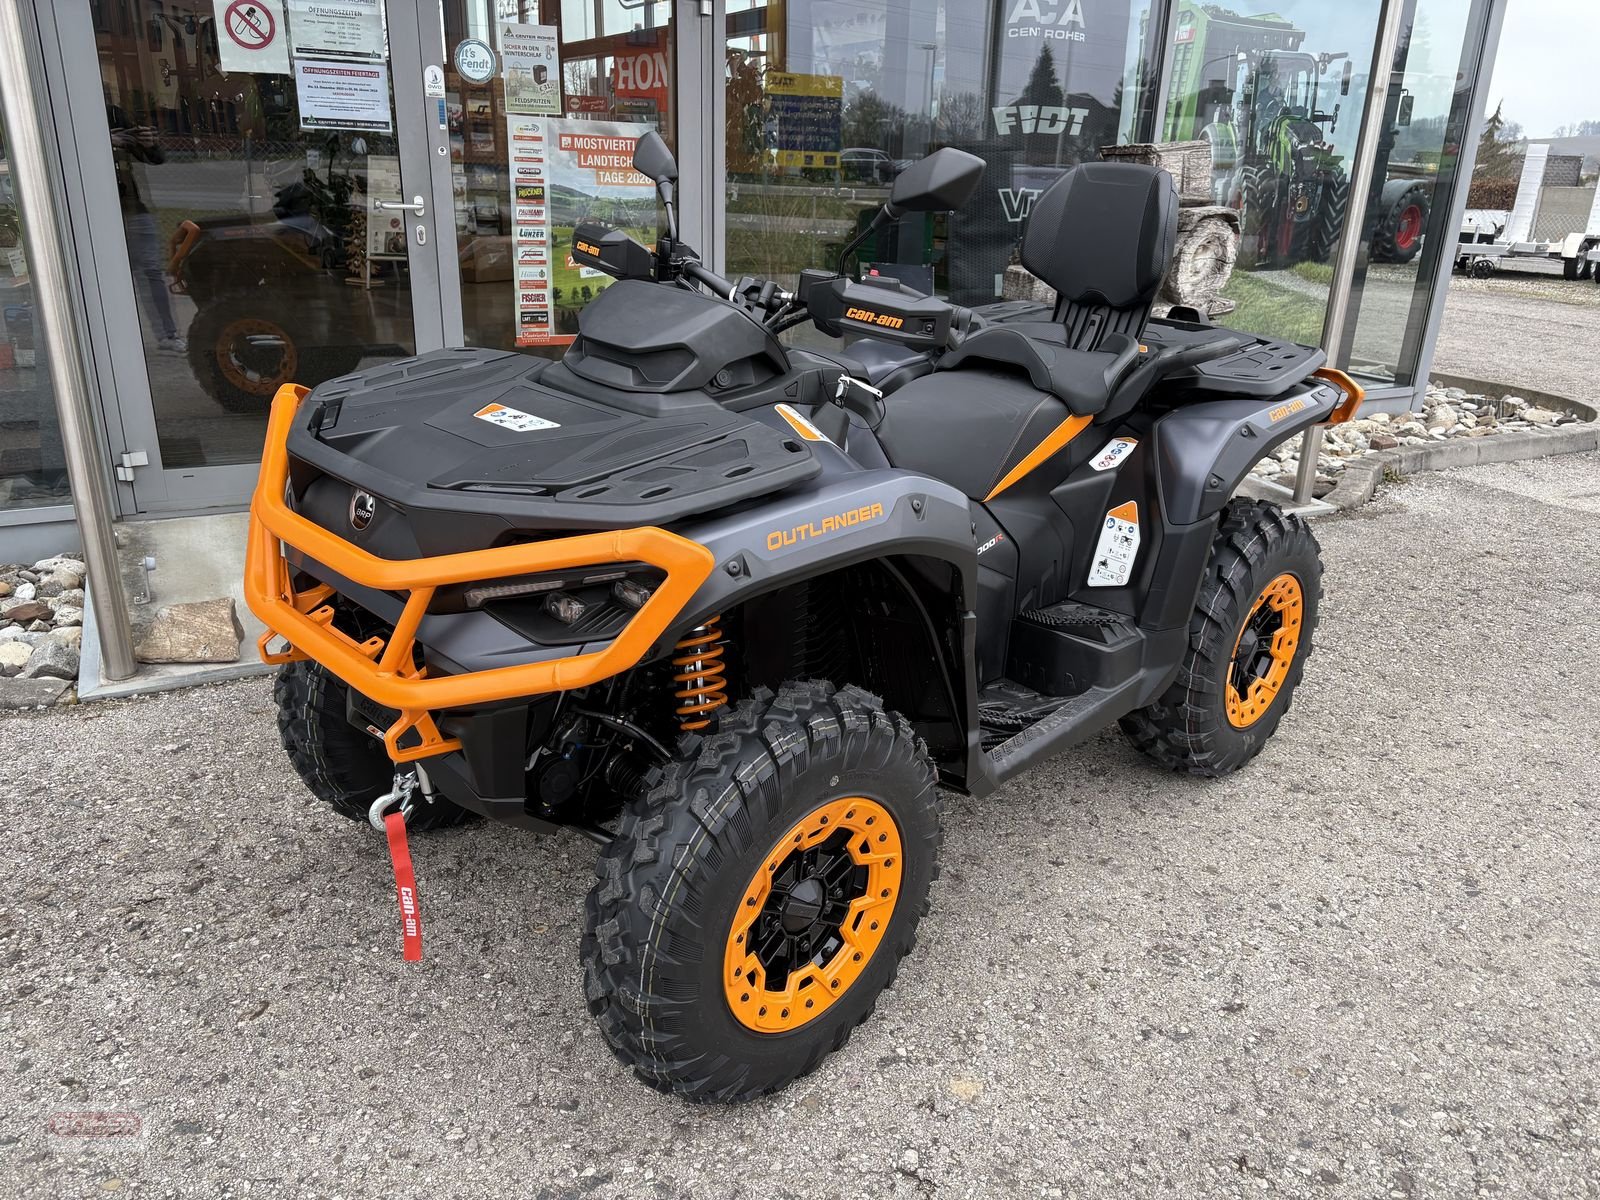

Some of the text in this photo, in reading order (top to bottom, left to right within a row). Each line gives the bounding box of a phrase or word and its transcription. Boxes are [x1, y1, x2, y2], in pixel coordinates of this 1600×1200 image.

[308, 6, 362, 16] ÖFFNUNGSZEITEN
[1044, 30, 1085, 42] ROHER
[303, 67, 351, 76] ÖFFNUNGSZEITEN
[615, 52, 668, 90] HON
[574, 138, 635, 150] MOSTVIERT
[581, 154, 633, 167] LANDTECH
[599, 172, 652, 184] TAGE 2026
[519, 228, 544, 238] LUNZER
[576, 241, 600, 256] can-am
[522, 294, 546, 302] FISCHER
[846, 307, 904, 329] can-am
[1269, 400, 1306, 421] can-am
[356, 508, 371, 518] BRP
[767, 502, 884, 550] OUTLANDER
[976, 534, 1003, 555] 000R
[401, 886, 417, 937] can-am
